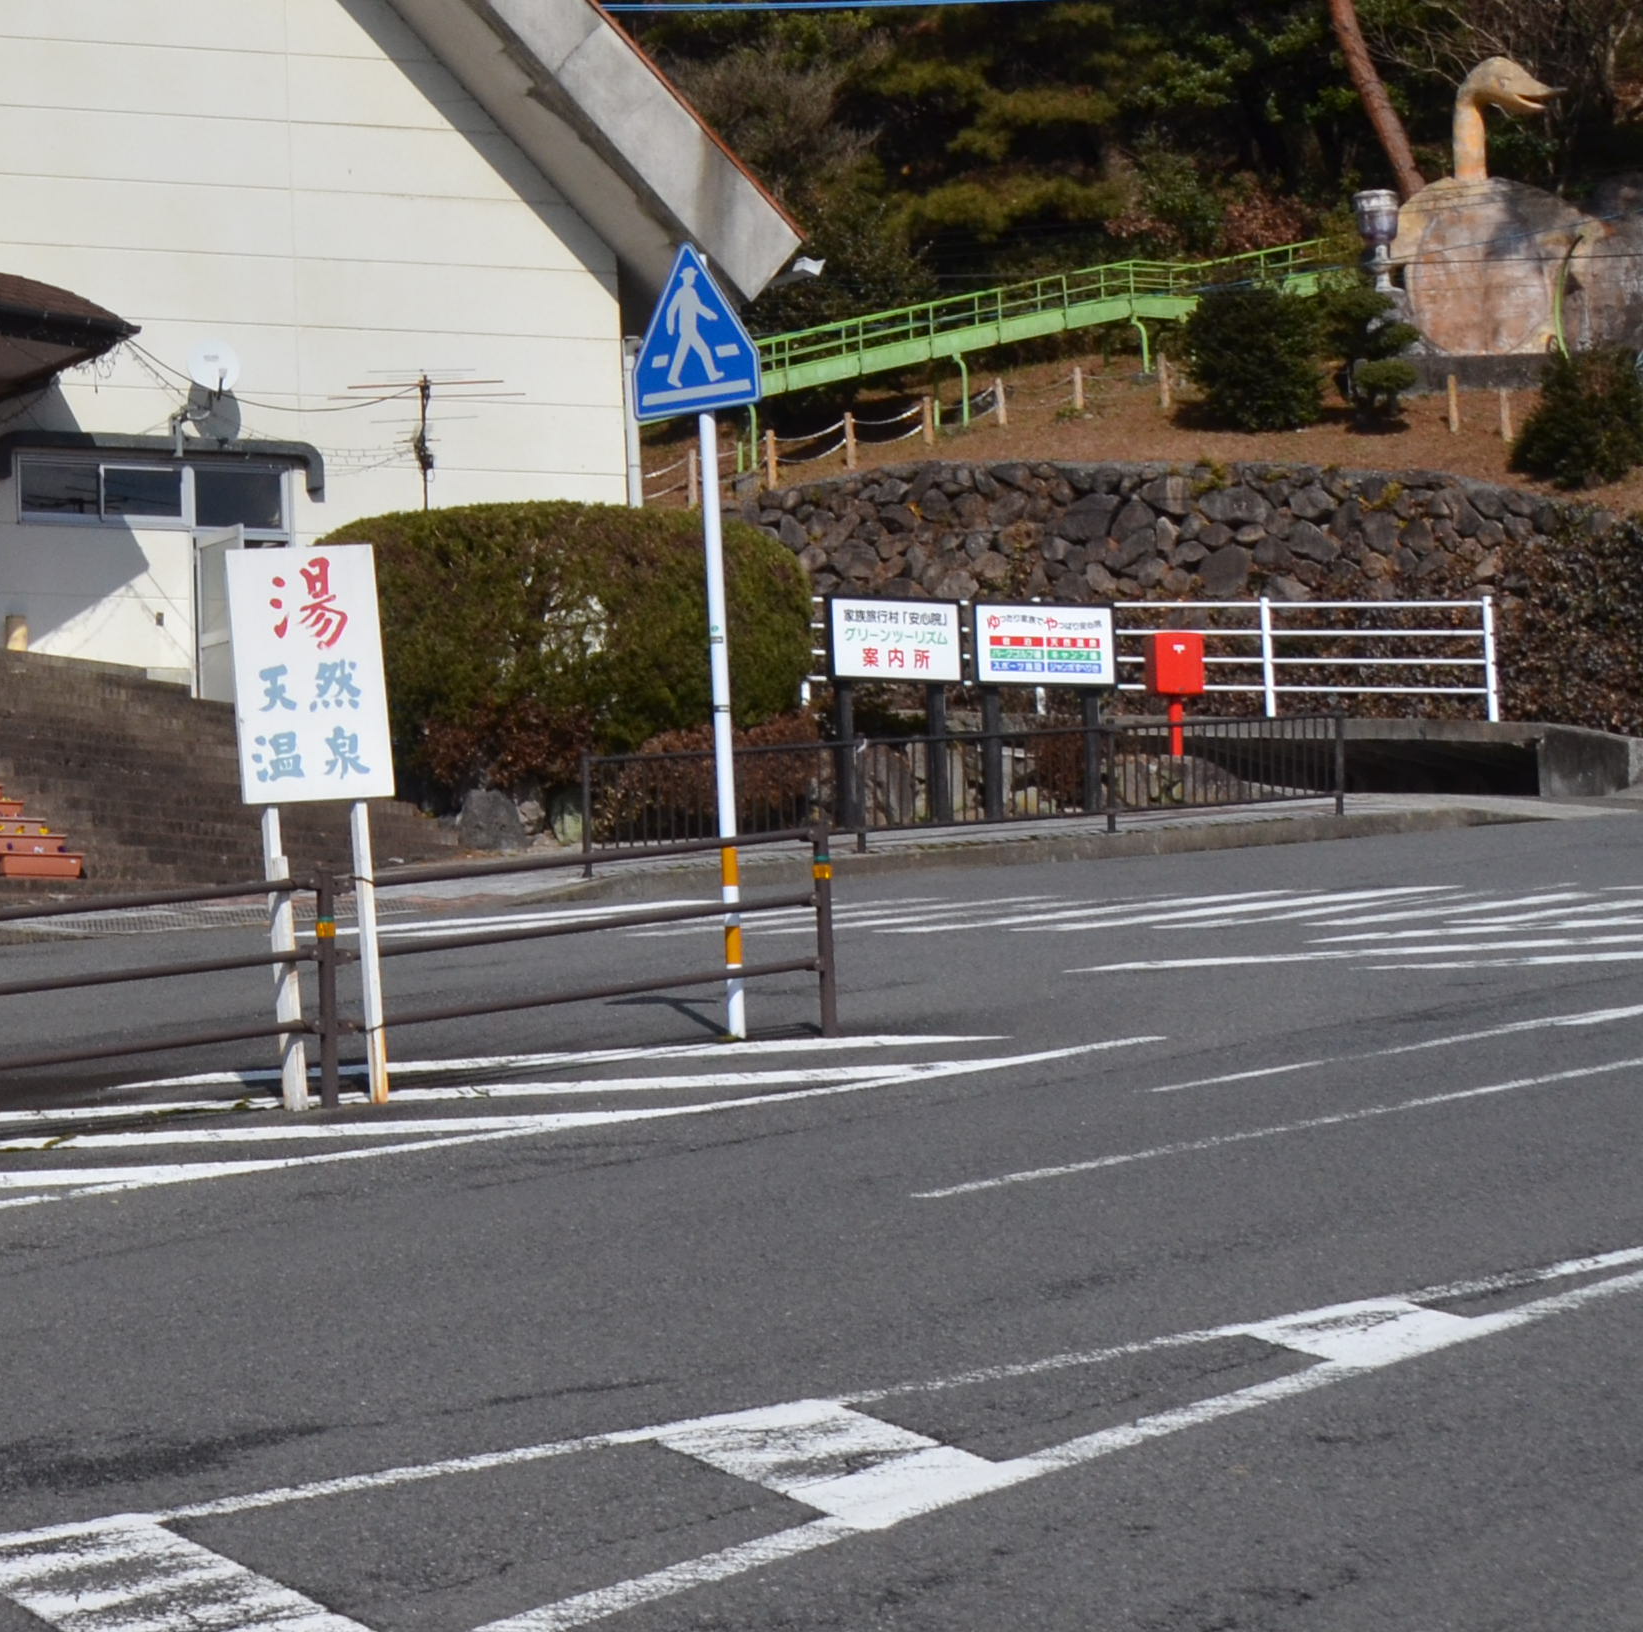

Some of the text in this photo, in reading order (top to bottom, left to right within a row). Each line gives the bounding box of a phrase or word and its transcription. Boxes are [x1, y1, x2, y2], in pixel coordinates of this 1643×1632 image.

[269, 556, 348, 650] 湯
[844, 626, 948, 645] グリーンツーリズム
[861, 646, 931, 669] 案内所
[258, 658, 362, 712] 天然
[251, 725, 370, 782] 温泉
